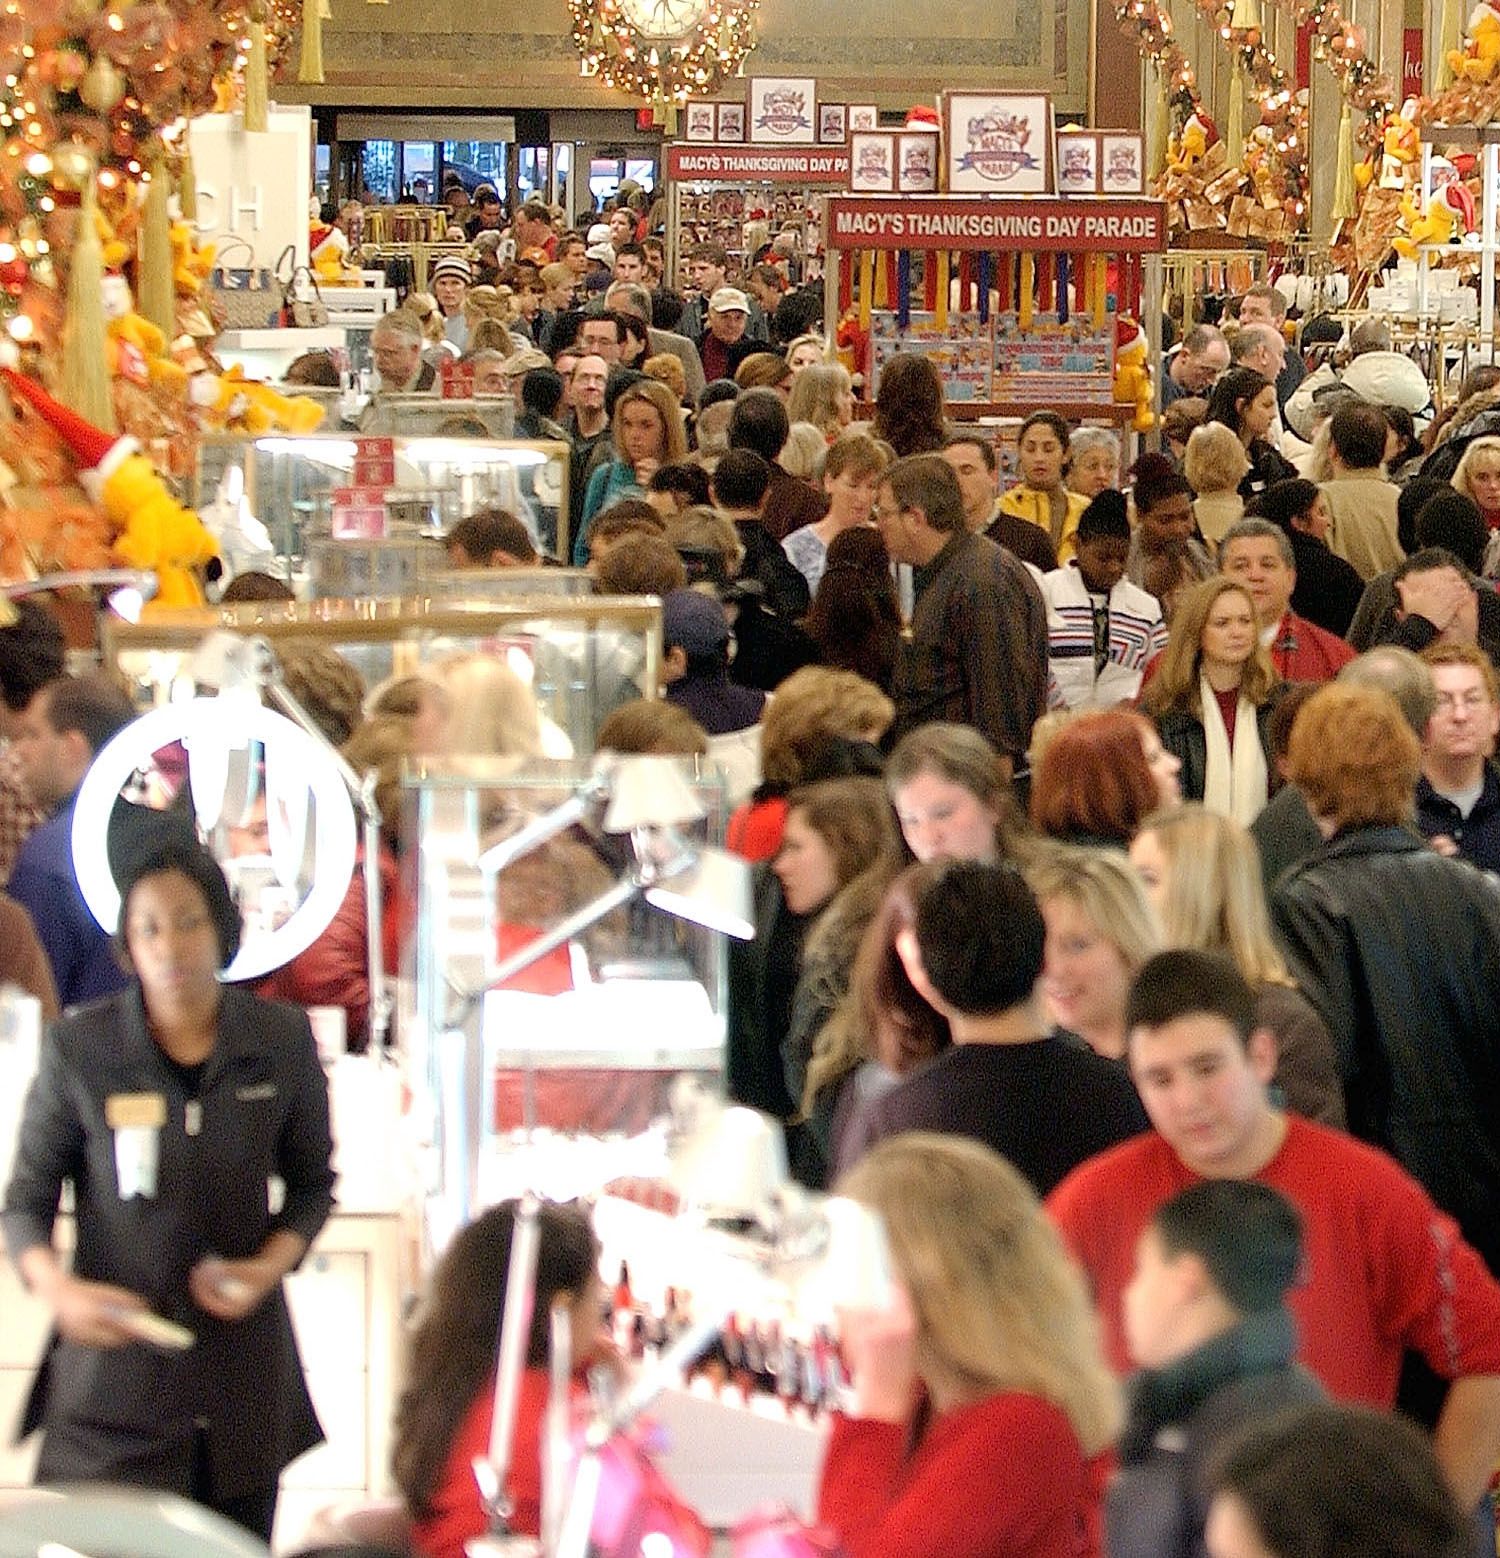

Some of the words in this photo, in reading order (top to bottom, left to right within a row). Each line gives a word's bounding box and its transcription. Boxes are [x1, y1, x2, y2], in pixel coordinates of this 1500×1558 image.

[679, 154, 720, 171] MACY'S
[722, 156, 808, 172] THANKSGIVING
[809, 157, 834, 173] DAY
[836, 211, 904, 234] MACY'S
[906, 213, 1049, 237] THANKSGIVING
[1046, 215, 1081, 238] DAY
[1085, 216, 1157, 238] PARADE
